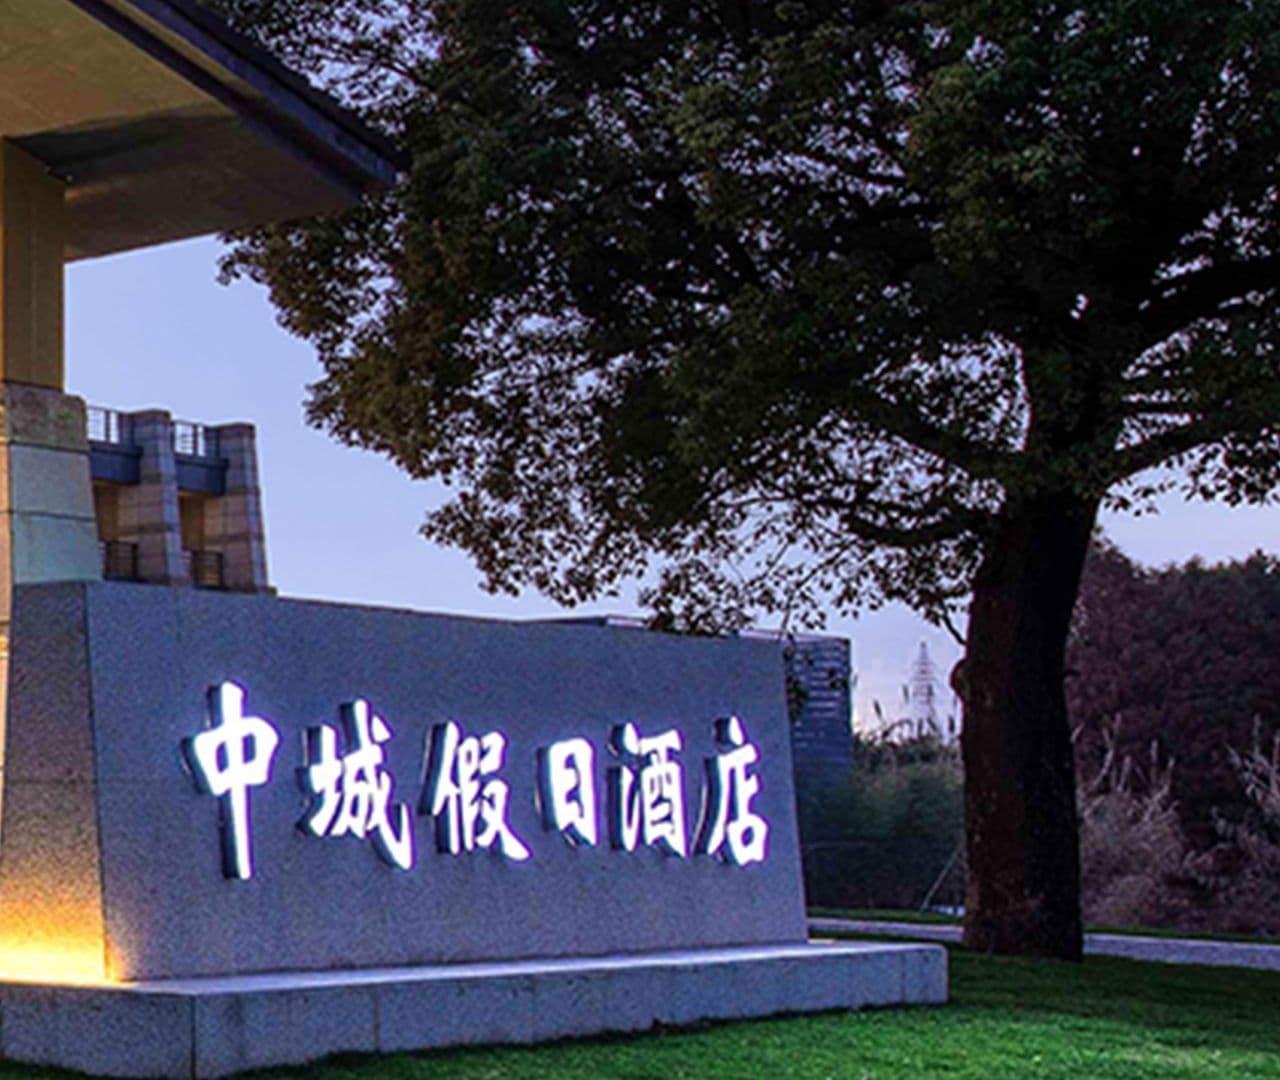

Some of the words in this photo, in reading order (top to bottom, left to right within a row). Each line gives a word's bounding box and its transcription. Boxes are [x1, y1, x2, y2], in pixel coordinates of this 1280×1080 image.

[190, 680, 769, 880] 中城假日酒店
